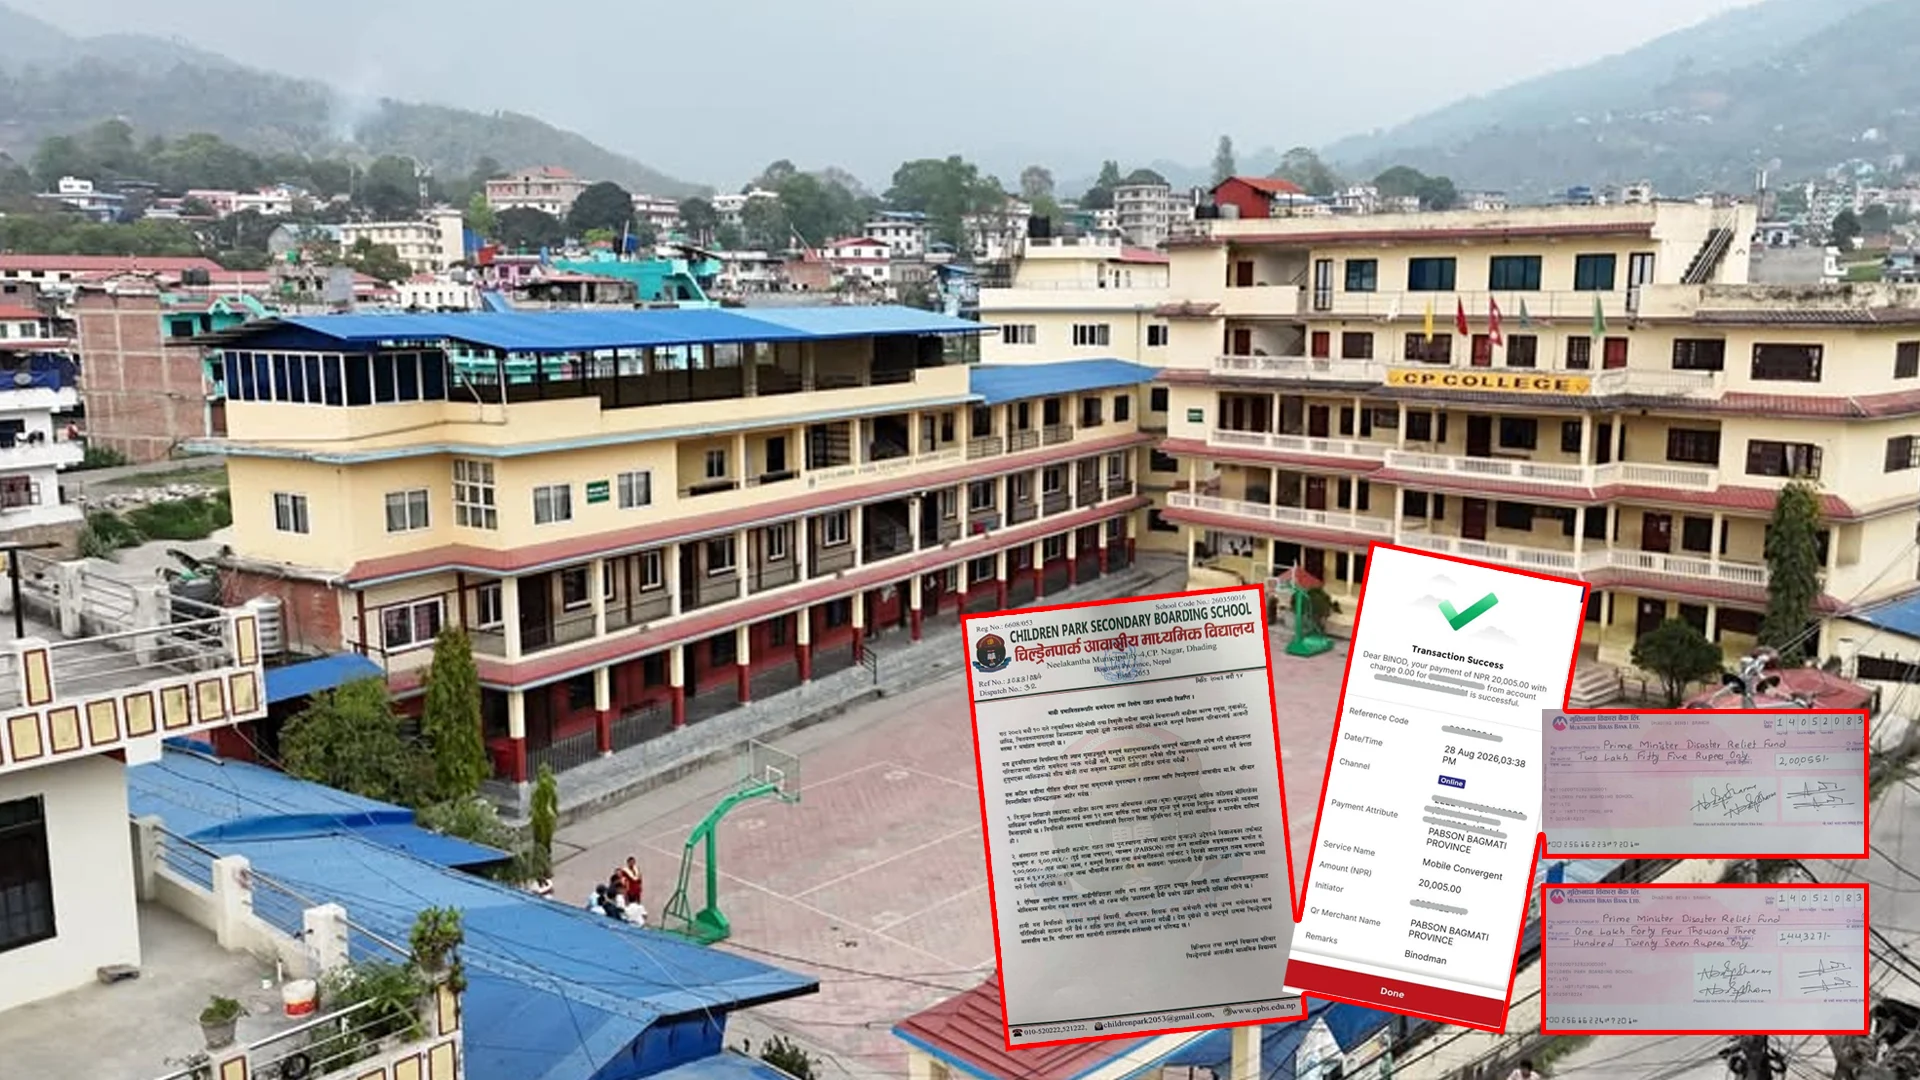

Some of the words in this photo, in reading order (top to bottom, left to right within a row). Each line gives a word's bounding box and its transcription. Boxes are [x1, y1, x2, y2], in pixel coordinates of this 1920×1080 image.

[1404, 372, 1435, 384] CP
[1442, 374, 1569, 390] COLLEGE
[1155, 601, 1177, 611] School
[1177, 600, 1195, 608] Code
[975, 626, 989, 634] Reg
[1009, 625, 1060, 643] CHILDREN
[1061, 621, 1089, 637] PARK
[1090, 613, 1151, 633] SECONDARY
[1153, 607, 1208, 625] BOARDING
[1210, 602, 1252, 619] SCHOOL
[1083, 632, 1139, 654] आवासीय
[1140, 625, 1202, 646] माध्यमिक
[1203, 621, 1255, 639] विद्यालय
[1046, 657, 1091, 669] Neelakantha
[1160, 647, 1185, 656] Nagar,
[1186, 643, 1218, 653] Dhading
[1152, 657, 1172, 666] Nepal
[1412, 644, 1465, 662] Transaction
[1467, 655, 1504, 670] Success
[1362, 650, 1382, 660] Dear
[1382, 654, 1409, 667] BINOD,
[1410, 661, 1429, 670] your
[1429, 664, 1463, 676] payment
[1463, 670, 1473, 678] of
[1473, 672, 1491, 682] NPR
[1491, 675, 1530, 689] 20,005.00
[1530, 684, 1548, 693] with
[978, 679, 991, 688] Ref
[1369, 662, 1397, 674] charge
[1397, 666, 1415, 677] 0.00
[1416, 670, 1428, 679] for
[1486, 683, 1505, 694] from
[1505, 689, 1537, 701] account
[979, 687, 1008, 697] Dispatch
[1469, 690, 1477, 699] is
[1477, 693, 1519, 707] successful.
[1349, 707, 1388, 721] Reference
[1388, 714, 1409, 726] Code
[1344, 732, 1383, 747] Date/Time
[1604, 740, 1633, 750] Prime
[1639, 741, 1678, 749] Minister
[1687, 740, 1721, 749] Disaster
[1727, 740, 1757, 749] Relief
[1763, 739, 1787, 749] Fund
[1339, 757, 1371, 770] Channel
[1441, 755, 1457, 766] PM
[1444, 744, 1456, 755] 28
[1457, 747, 1475, 760] Aug
[1476, 751, 1526, 768] 2026,03:38
[1578, 752, 1598, 762] Two
[1604, 753, 1629, 762] Lakh
[1667, 752, 1688, 761] Five
[1696, 752, 1724, 761] Rupees
[1440, 777, 1464, 787] Online
[1330, 798, 1364, 812] Payment
[1365, 805, 1399, 819] Attribute
[1426, 837, 1472, 854] PROVINCE
[1428, 827, 1465, 842] PABSON
[1466, 834, 1507, 850] BAGMATI
[1323, 839, 1352, 852] Service
[1353, 845, 1376, 857] Name
[1318, 860, 1349, 873] Amount
[1350, 866, 1372, 878] (NPR)
[1422, 858, 1452, 871] Mobile
[1453, 863, 1503, 881] Convergent
[1315, 881, 1344, 893] Initiator
[1418, 878, 1462, 894] 20,005.00
[1310, 906, 1320, 915] Qr
[1321, 908, 1357, 922] Merchant
[1358, 915, 1381, 927] Name
[1602, 914, 1631, 923] Prime
[1637, 914, 1674, 923] Minister
[1682, 914, 1717, 923] Disaster
[1722, 914, 1751, 924] Relief
[1408, 929, 1454, 946] PROVINCE
[1410, 918, 1447, 933] PABSON
[1448, 926, 1490, 941] BAGMATI
[1575, 927, 1594, 936] One
[1600, 927, 1626, 936] Lakh
[1631, 926, 1656, 939] Forty
[1662, 928, 1683, 936] Four
[1688, 926, 1730, 936] Thousand
[1734, 926, 1757, 936] Three
[1305, 931, 1338, 945] Remarks
[1573, 939, 1615, 948] Hundred
[1625, 938, 1659, 951] Twenty
[1664, 939, 1690, 948] Seven
[1694, 939, 1725, 949] Rupees
[1404, 949, 1447, 965] Binodman
[1380, 986, 1405, 999] Done
[1230, 1003, 1296, 1015] www.cpbs.edu.np
